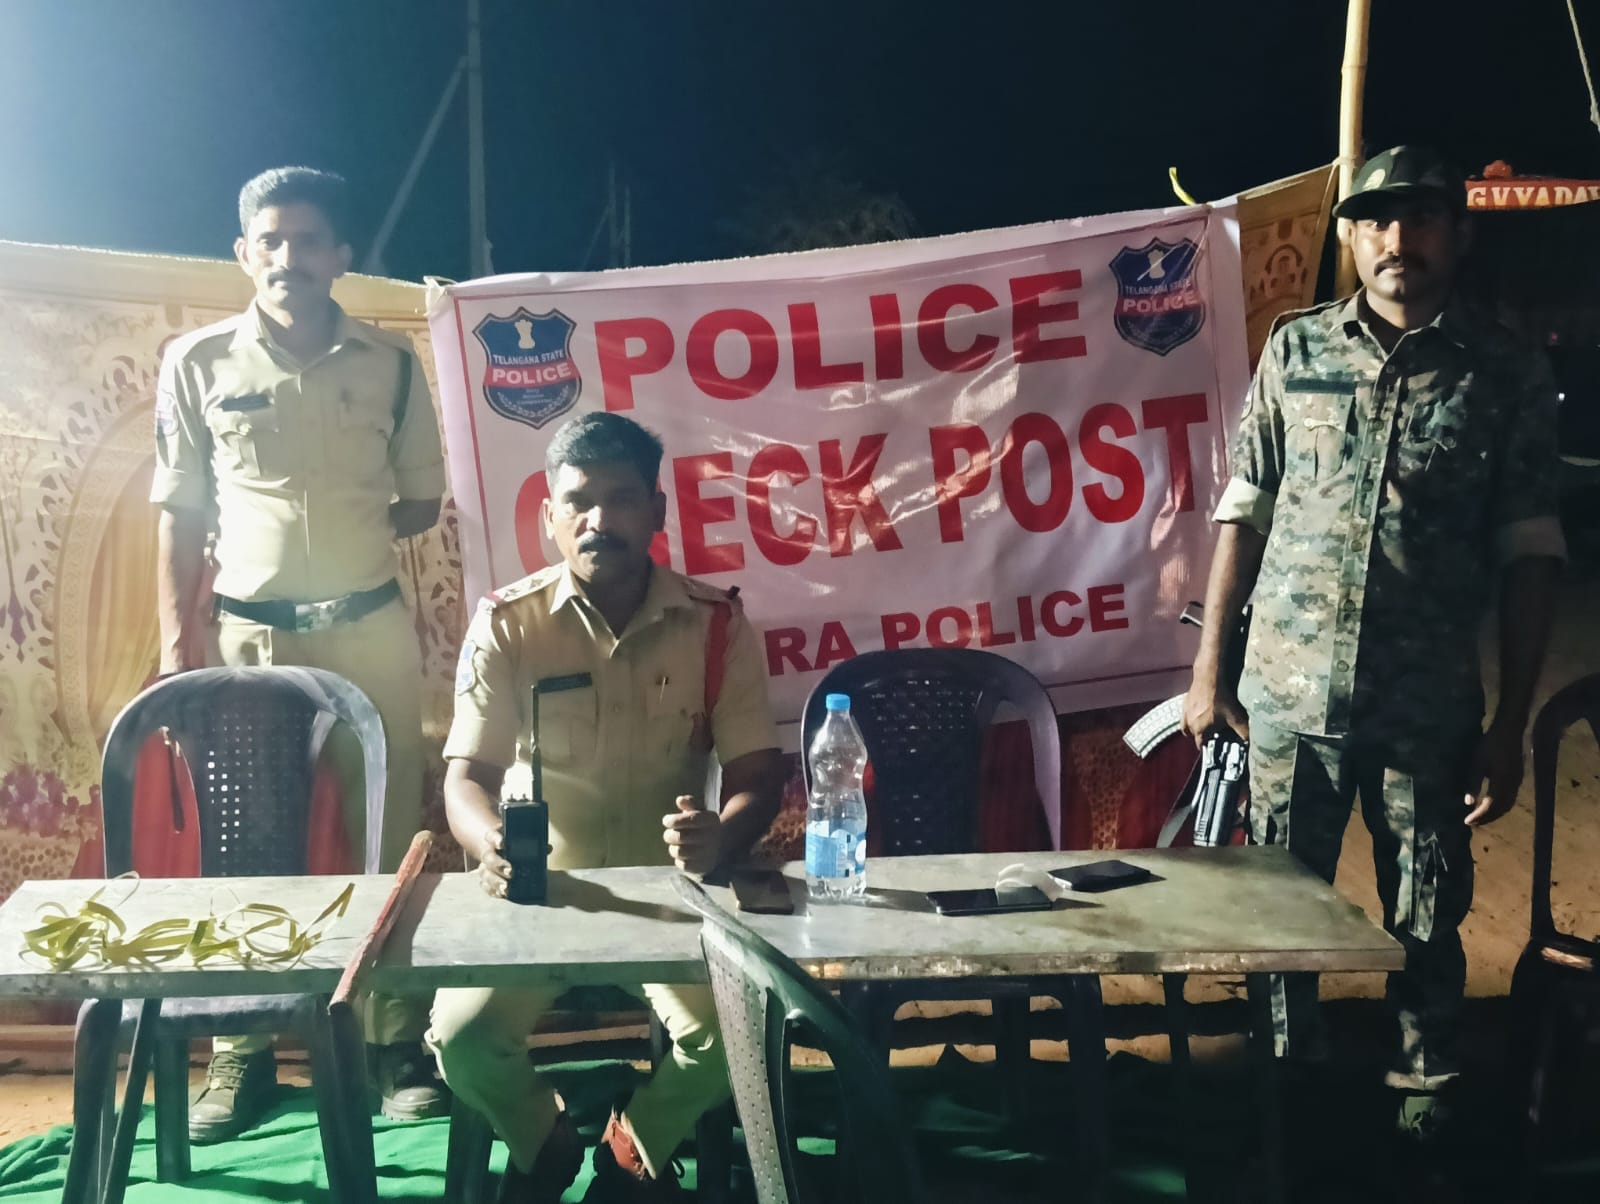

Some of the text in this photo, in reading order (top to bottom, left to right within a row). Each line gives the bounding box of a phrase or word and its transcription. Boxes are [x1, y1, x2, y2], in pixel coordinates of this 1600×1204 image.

[1122, 289, 1198, 313] POLICE
[493, 349, 564, 365] TELANGANA STATE
[594, 269, 1088, 411] POLICE
[492, 362, 572, 384] POLICE
[514, 393, 1208, 577] CECK POST
[880, 583, 1130, 652] POLICE
